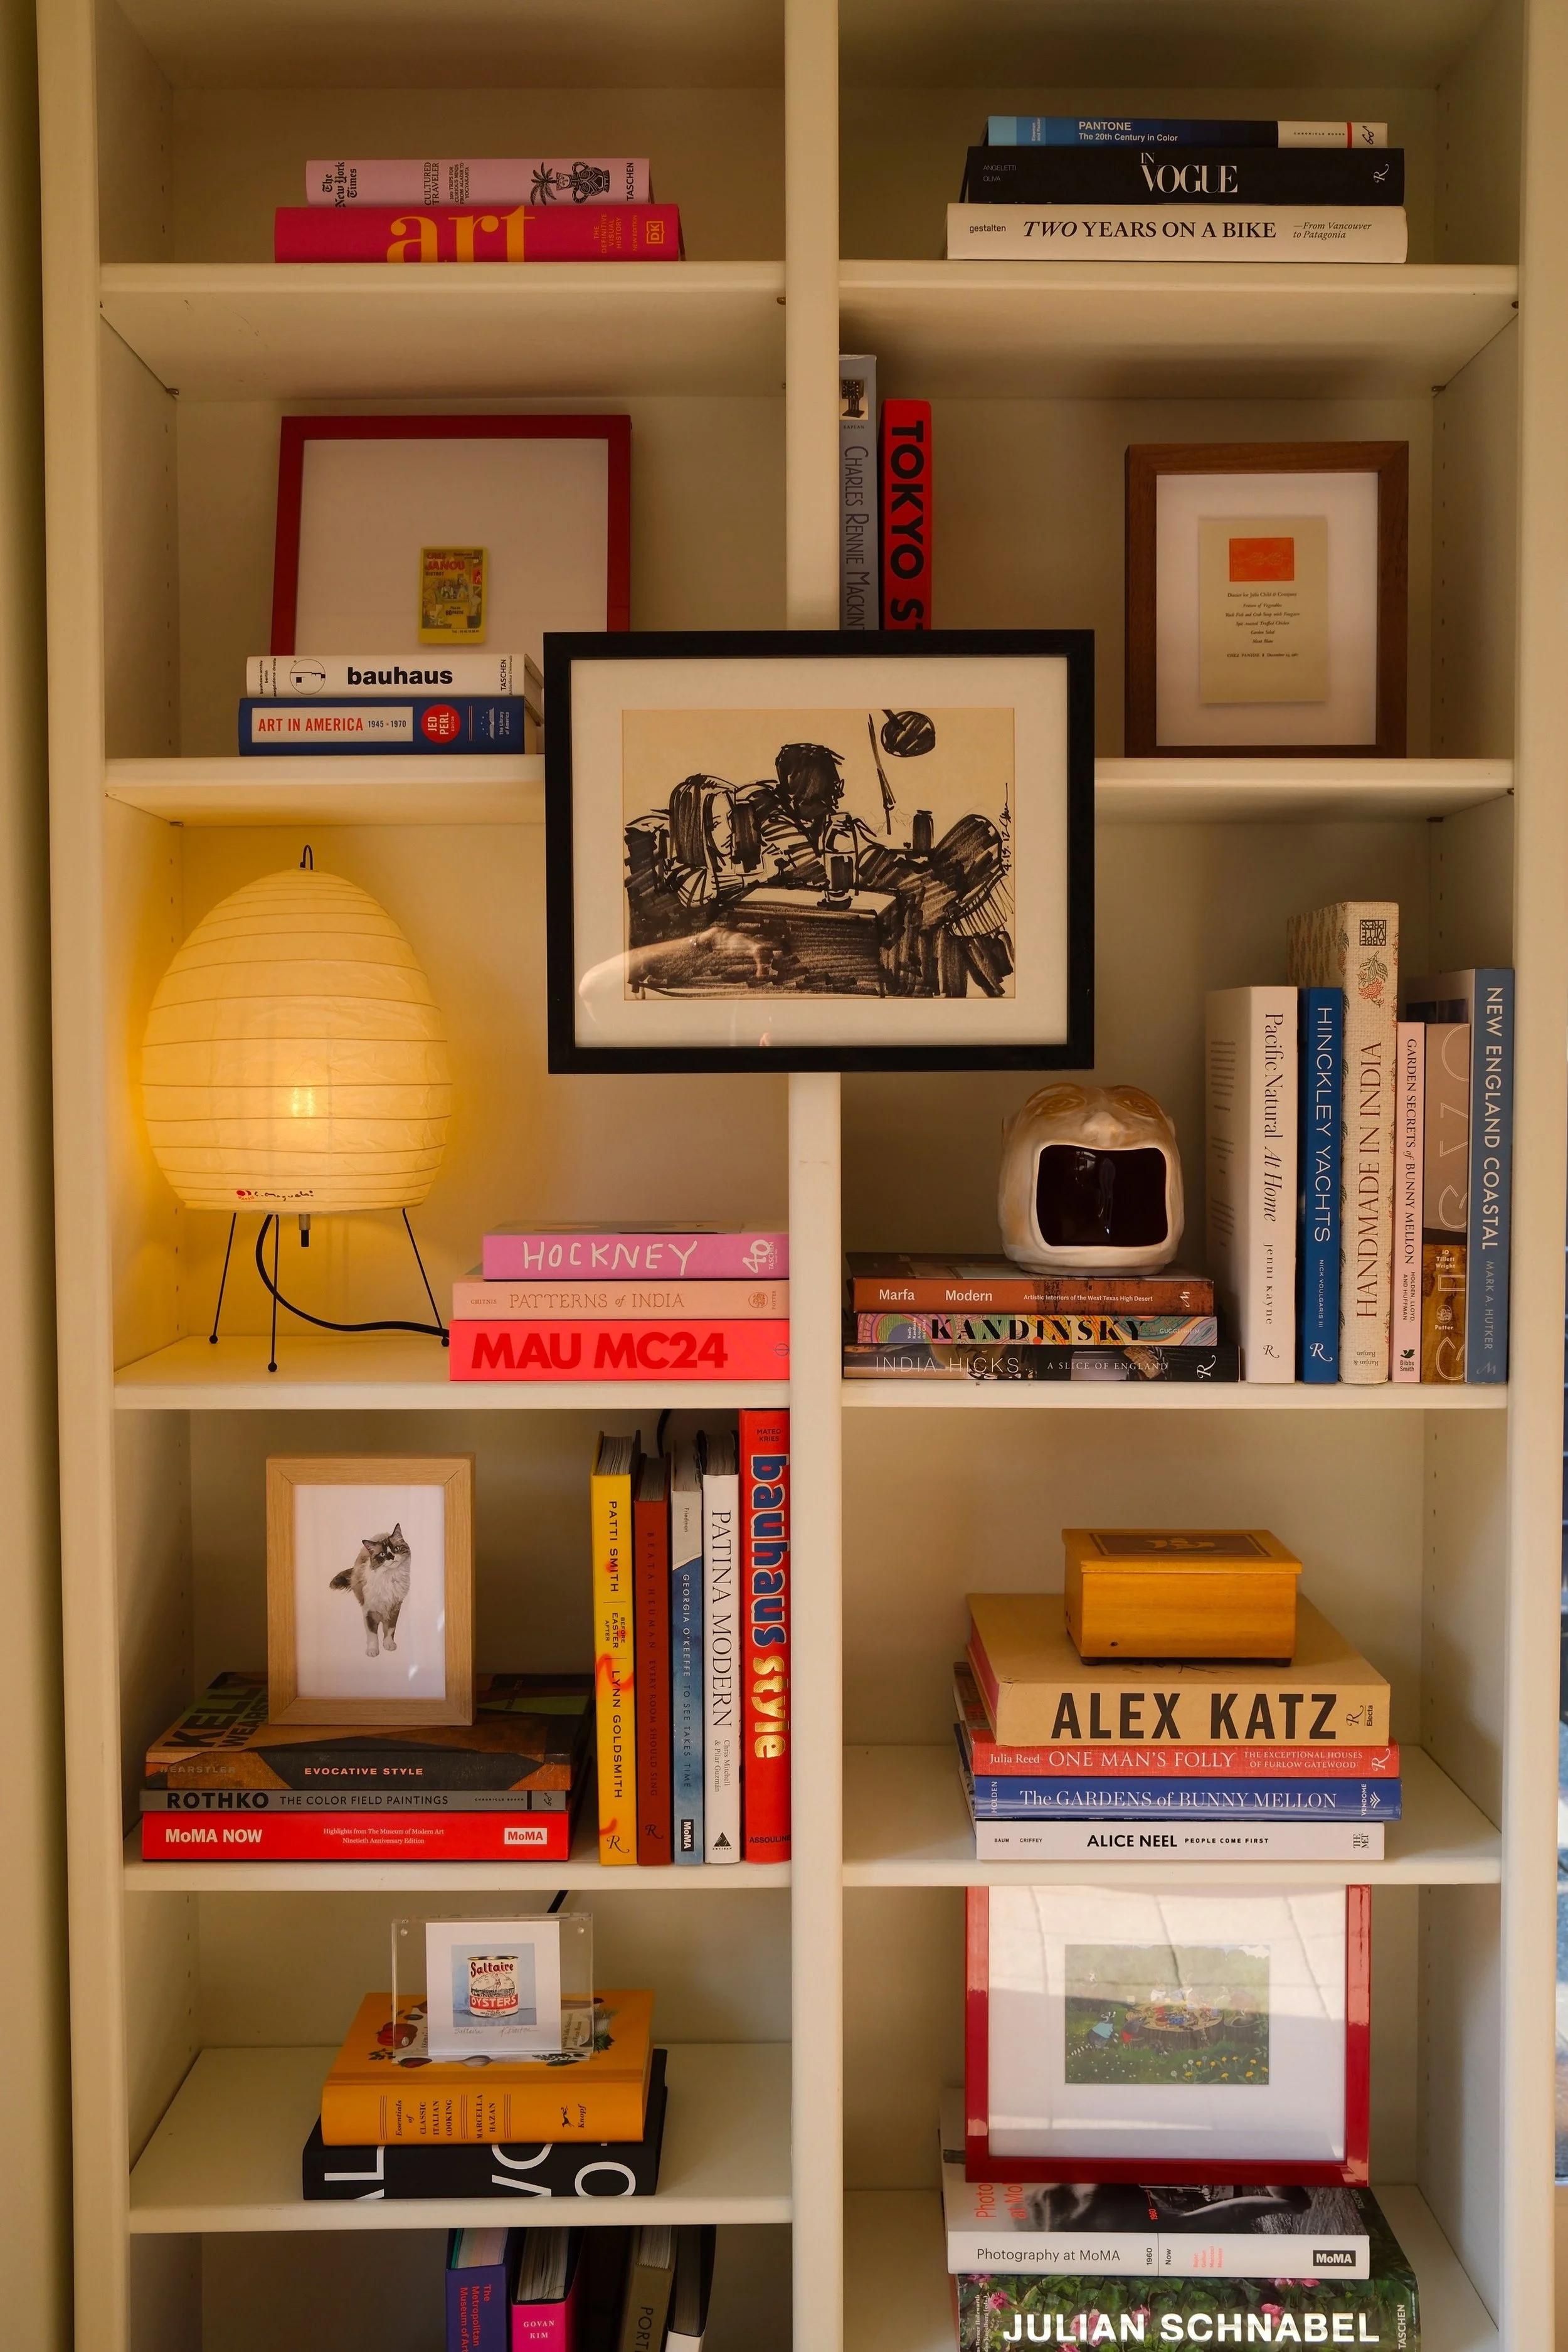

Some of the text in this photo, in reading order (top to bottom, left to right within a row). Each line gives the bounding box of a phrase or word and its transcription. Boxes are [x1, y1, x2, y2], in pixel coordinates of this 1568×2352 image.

[1079, 121, 1132, 131] PANTONE
[1079, 132, 1179, 143] The 20th Century in Color
[1140, 152, 1155, 164] IN
[347, 167, 358, 199] Times
[626, 162, 634, 202] TASCHEN
[1140, 164, 1238, 194] VOGUE
[387, 205, 536, 263] art
[969, 224, 1007, 235] gestalten
[1023, 221, 1277, 238] TWO YEARS ON A BIKE
[890, 420, 924, 630] TOKYO S
[347, 666, 453, 686] bauhaus
[258, 718, 283, 732] ART
[287, 718, 300, 732] IN
[305, 717, 364, 731] AMERICA
[368, 720, 384, 728] 1945
[427, 716, 438, 732] JED
[439, 712, 449, 735] PERL
[1264, 1013, 1285, 1222] Pacific Natural At Home
[1314, 1007, 1333, 1242] HINCKLEY YACHTS
[1482, 987, 1504, 1251] NEW ENGLAND COASTAL
[1404, 1038, 1417, 1265] GARDEN SECRETS of BUNNY MELLON
[1357, 1041, 1382, 1318] HANDMADE IN INDIA
[523, 1239, 697, 1276] HOCKNEY
[509, 1292, 685, 1309] PATTERNS of INDIA
[879, 1288, 993, 1301] Marfa Modern
[931, 1319, 1145, 1342] KANDINSKY
[471, 1331, 728, 1370] MAU MC24
[875, 1356, 1019, 1374] INDIA HICKS
[608, 1500, 619, 1592] PATTI SMITH
[647, 1532, 656, 1650] BEATA HEUMAN
[750, 1453, 790, 1759] bauhaus style
[712, 1510, 733, 1728] PATINA MODERN
[1051, 1692, 1337, 1740] ALEX KATZ
[612, 1670, 623, 1799] LYNN GOLDSMITH
[990, 1753, 1041, 1764] Julia Reed
[1243, 1751, 1364, 1759] THE EXCEPTIONAL HOUSES
[159, 1766, 236, 1774] WEARSTLER
[304, 1767, 423, 1776] EVOCATIVE STYLE
[167, 1792, 448, 1809] ROTHKO THE COLOR FIELD PAINTINGS
[990, 1781, 999, 1814] HOLDEN
[1019, 1790, 1338, 1809] The GARDENS of BUNNY MELLON
[165, 1828, 263, 1843] MoMA NOW
[507, 1831, 544, 1841] MoMA
[1086, 1835, 1178, 1848] ALICE NEEL
[1352, 1833, 1361, 1849] THE
[1360, 1833, 1369, 1849] MET
[470, 1961, 514, 1978] Saltaire
[471, 1995, 517, 2008] OYSTERS
[475, 2094, 484, 2139] MARCELLA
[977, 2247, 1121, 2263] Photography at MoMA
[1315, 2253, 1353, 2264] MoMA
[483, 2284, 492, 2302] The
[460, 2287, 469, 2326] Museum
[470, 2286, 481, 2347] Metropolitan
[523, 2320, 555, 2328] GOVAN
[461, 2328, 469, 2338] of
[529, 2331, 549, 2339] KIM
[635, 2306, 654, 2352] PORT
[1003, 2312, 1146, 2343] JULIAN
[1160, 2312, 1380, 2343] SCHNABEL
[1396, 2304, 1407, 2350] TASCHEN
